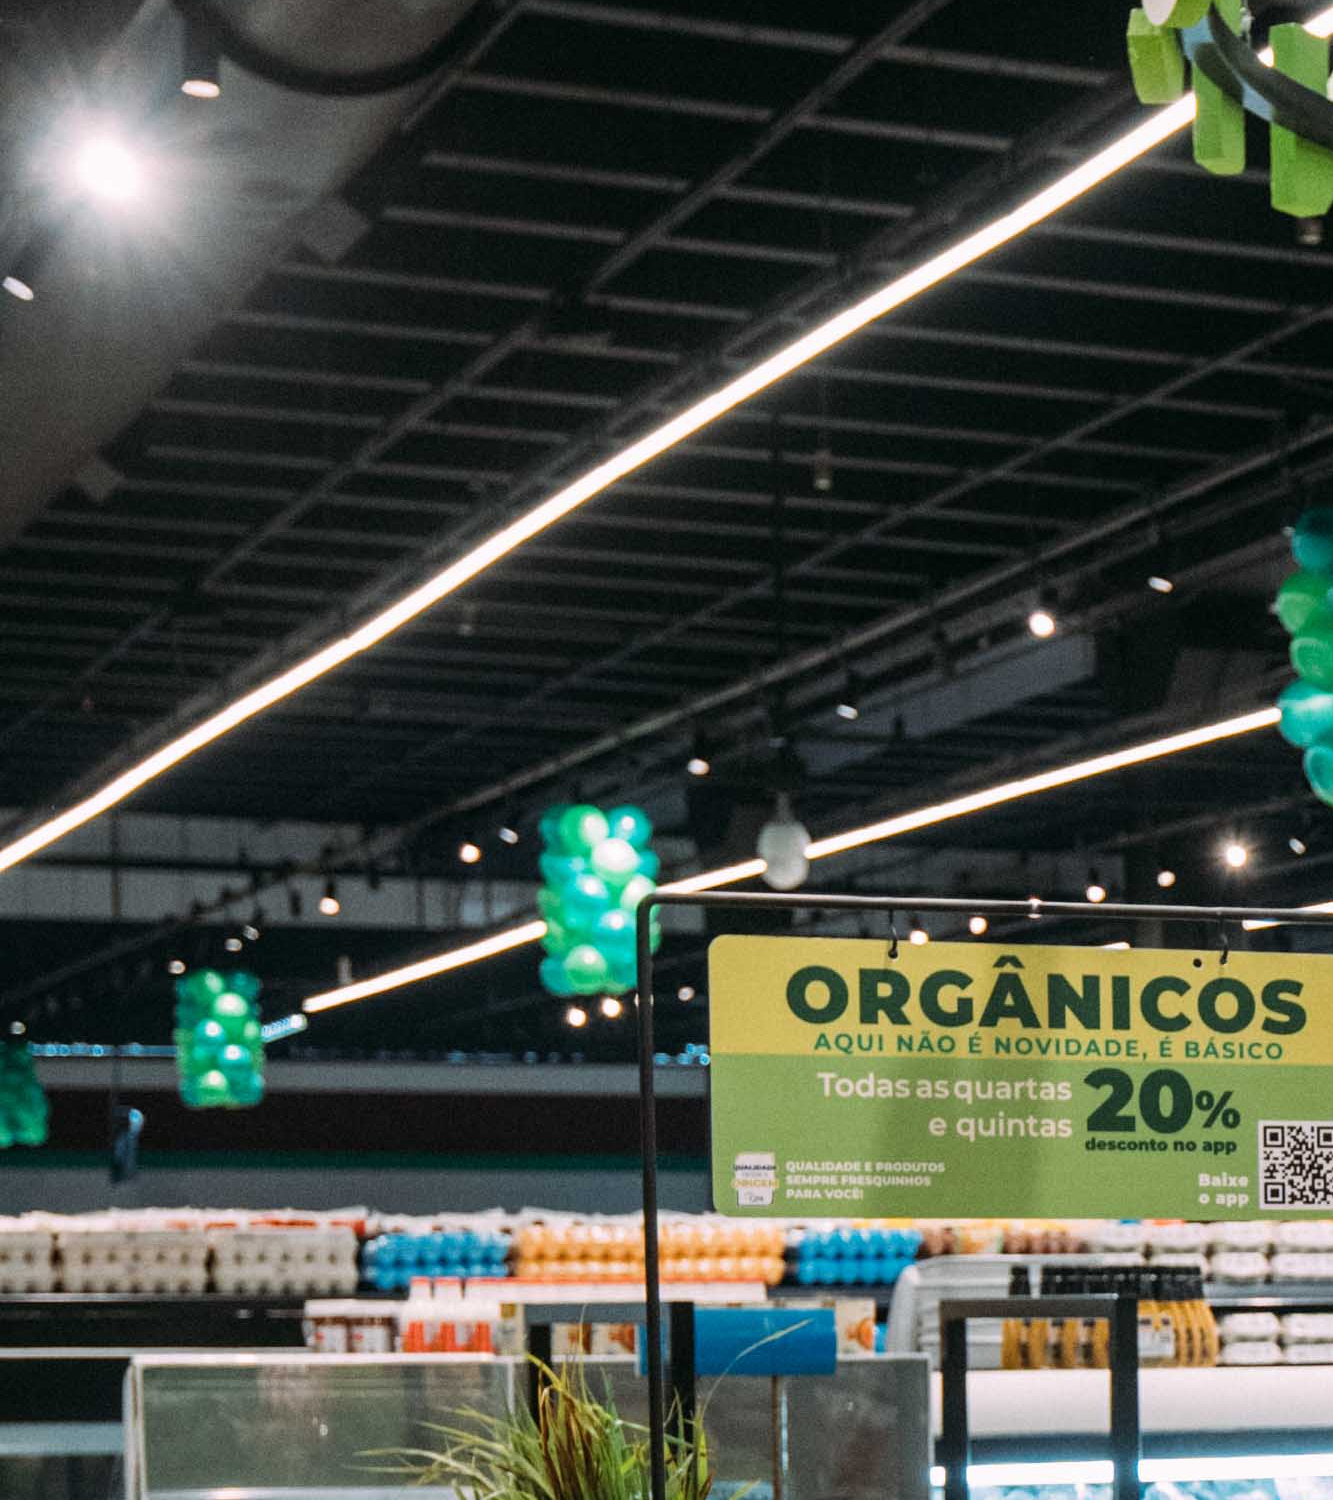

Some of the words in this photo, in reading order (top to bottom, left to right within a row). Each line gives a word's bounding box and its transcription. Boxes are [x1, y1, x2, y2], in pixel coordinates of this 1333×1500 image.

[785, 955, 1308, 1036] ORGÂNICOS
[813, 1032, 884, 1054] AQUI
[898, 1030, 955, 1055] NÃO
[968, 1031, 982, 1054] É
[995, 1035, 1149, 1061] NOVIDADE,
[1158, 1035, 1173, 1058] É
[1185, 1035, 1284, 1060] BÁSICO
[817, 1072, 910, 1100] Todas
[916, 1080, 949, 1100] as
[954, 1077, 1073, 1106] quartas
[1083, 1067, 1241, 1134] 20%
[928, 1117, 946, 1136] e
[956, 1111, 1073, 1143] quintas
[1085, 1137, 1168, 1152] desconto
[1173, 1139, 1196, 1152] no
[1202, 1139, 1237, 1155] app
[785, 1161, 861, 1172] QUALIDADE
[864, 1162, 872, 1171] E
[875, 1162, 945, 1173] PRODUTOS
[785, 1175, 838, 1186] SEMPRE
[841, 1176, 931, 1187] FRESQUINHOS
[1198, 1172, 1248, 1187] Baixe
[785, 1189, 822, 1199] PARA
[1198, 1194, 1210, 1205] o
[1215, 1194, 1248, 1208] app
